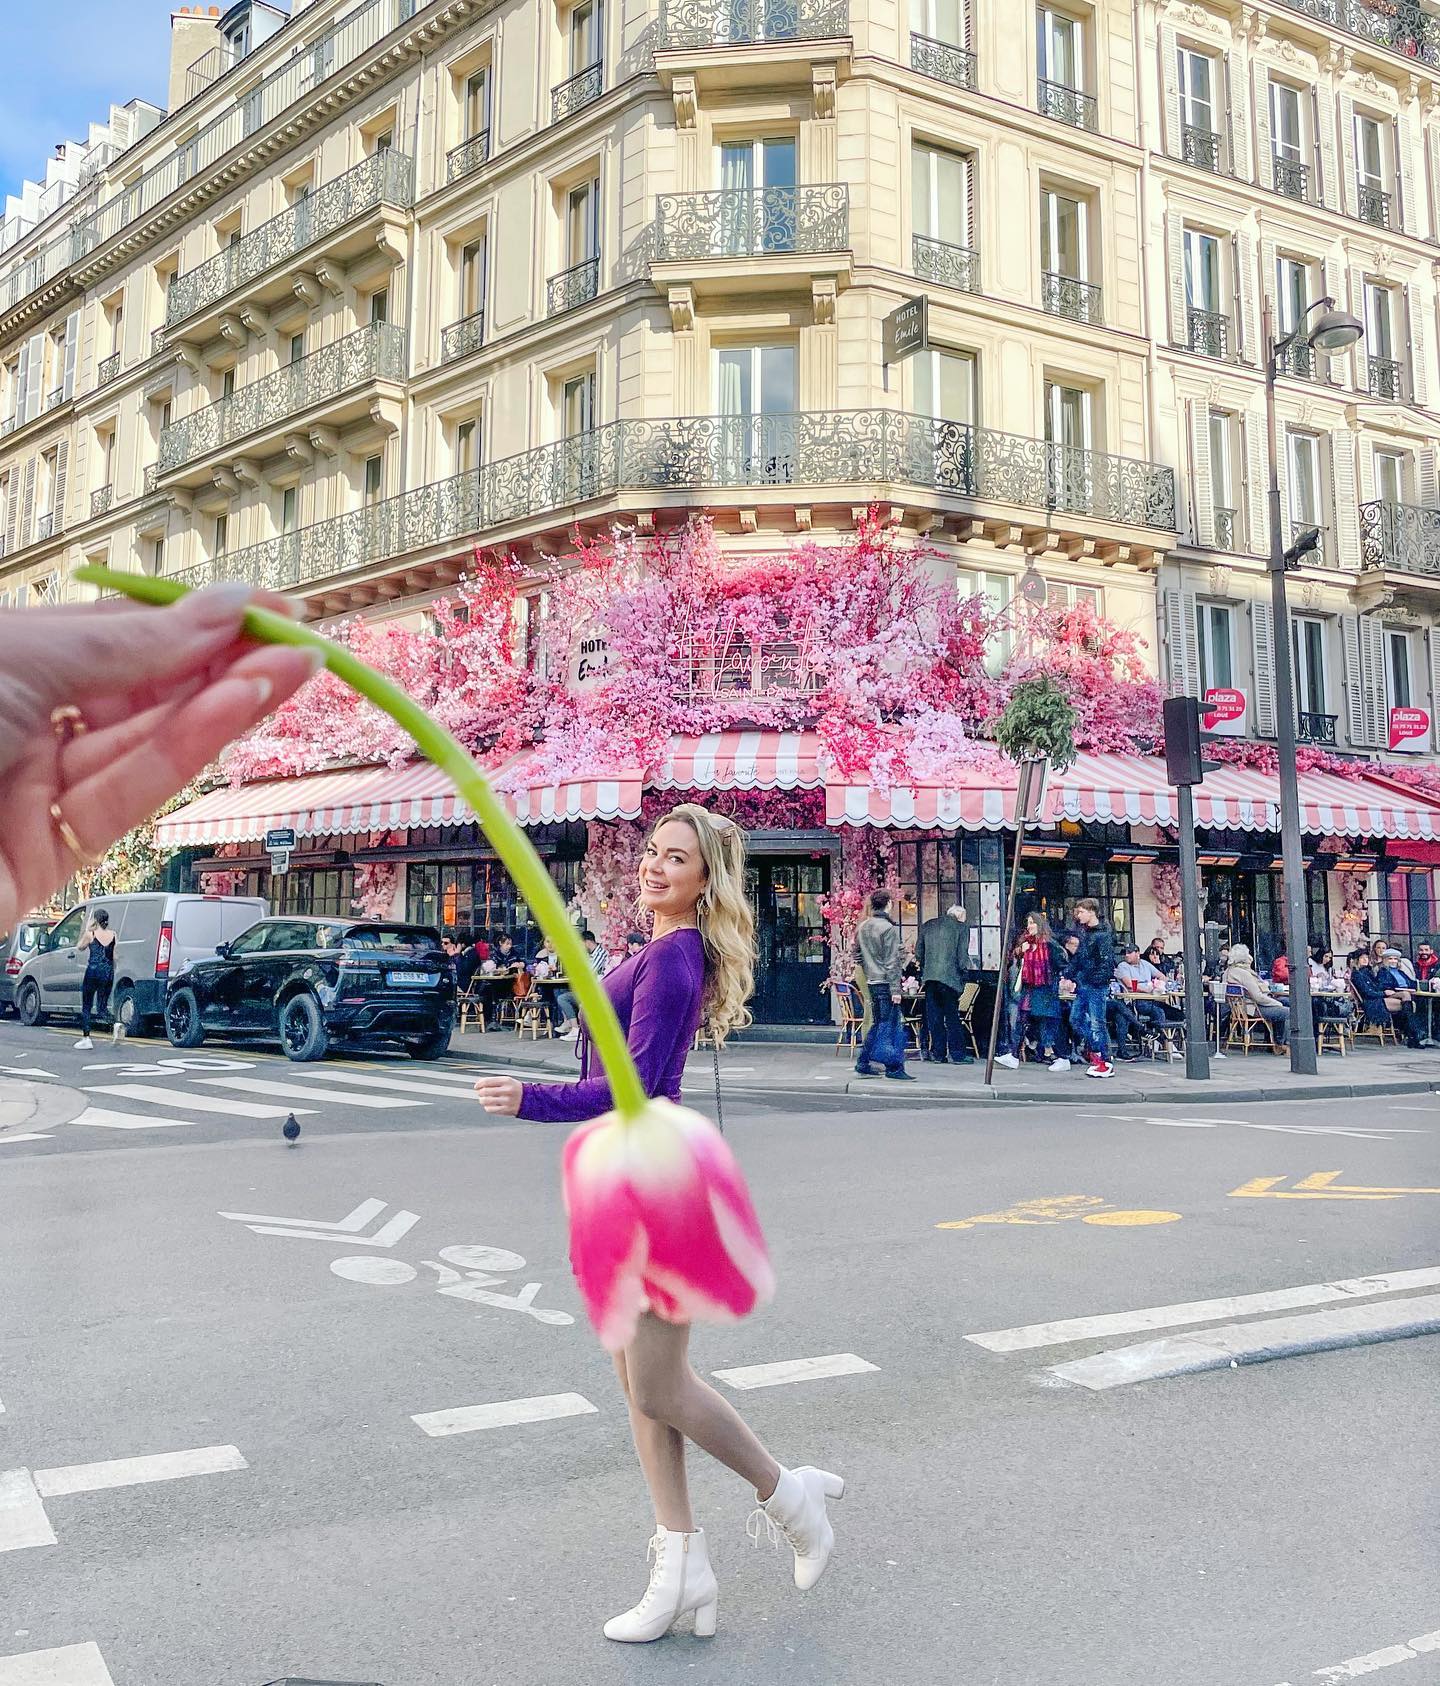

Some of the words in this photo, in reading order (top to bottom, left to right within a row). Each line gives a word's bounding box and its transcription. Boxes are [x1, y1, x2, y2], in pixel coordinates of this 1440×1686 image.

[895, 305, 919, 325] HOTEL
[894, 321, 920, 344] Emile
[580, 638, 611, 654] HOTE
[1208, 692, 1237, 705] plaza
[1392, 711, 1421, 723] plaza
[81, 1057, 257, 1077] 30
